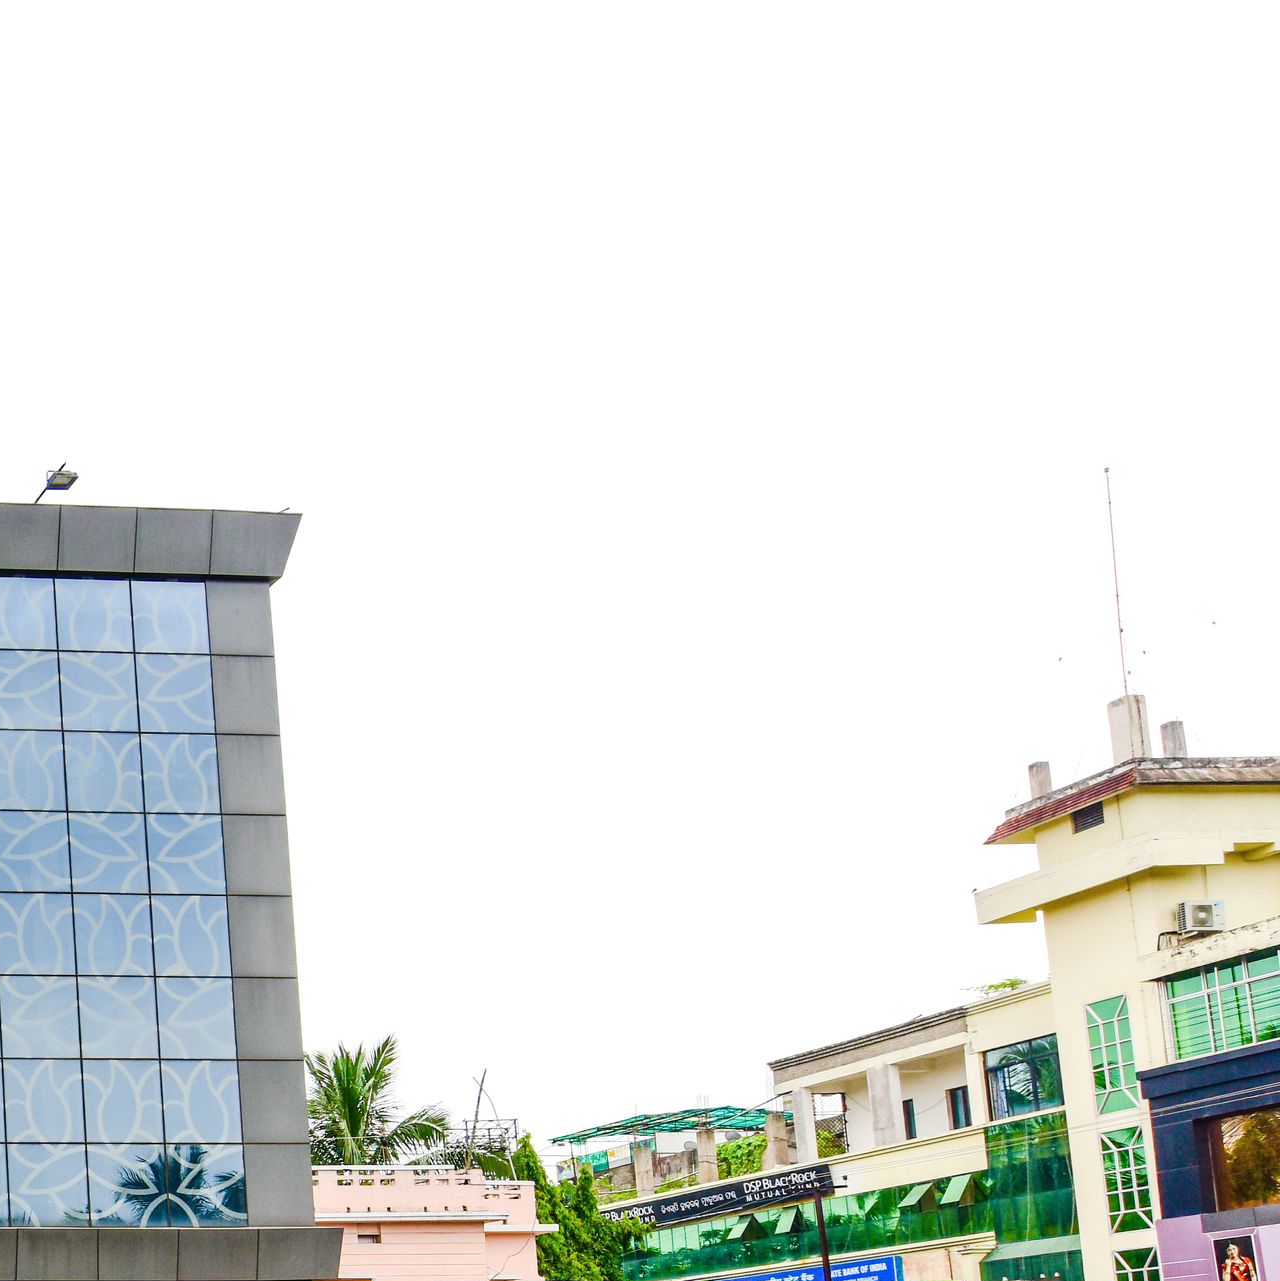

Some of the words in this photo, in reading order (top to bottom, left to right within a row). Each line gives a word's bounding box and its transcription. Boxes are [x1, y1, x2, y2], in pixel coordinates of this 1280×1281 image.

[746, 1188, 787, 1201] MUTUAL
[831, 1269, 842, 1278] ATE
[843, 1266, 860, 1276] BANK
[860, 1265, 869, 1273] OF
[870, 1262, 887, 1272] INDIA
